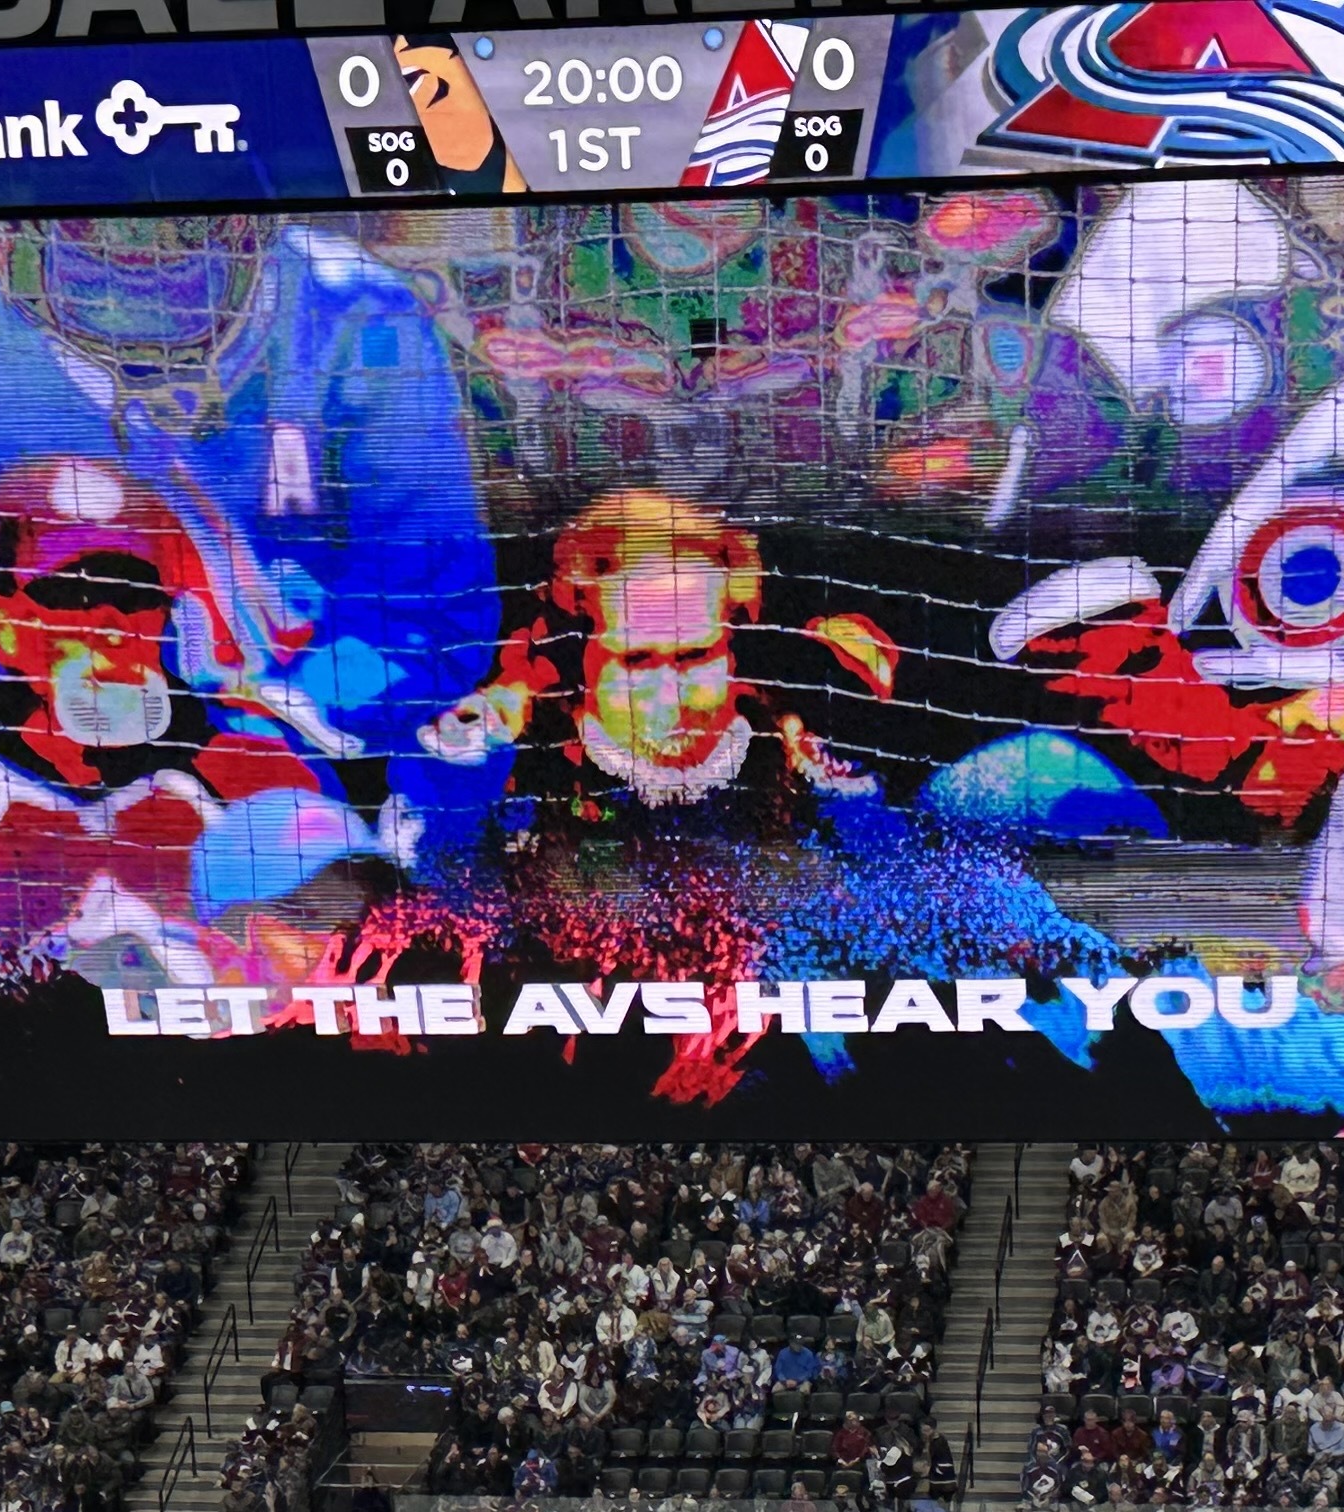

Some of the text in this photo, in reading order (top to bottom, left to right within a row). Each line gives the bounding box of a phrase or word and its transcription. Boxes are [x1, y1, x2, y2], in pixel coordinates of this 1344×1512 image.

[339, 56, 380, 108] 0
[522, 55, 684, 107] 20:00
[812, 38, 856, 92] 0
[368, 131, 416, 154] SOG
[549, 126, 641, 173] 1ST
[794, 115, 842, 138] SOG
[387, 158, 409, 187] 0
[805, 144, 828, 172] 0
[102, 974, 1300, 1037] LET THE AVS HEAR YOU
